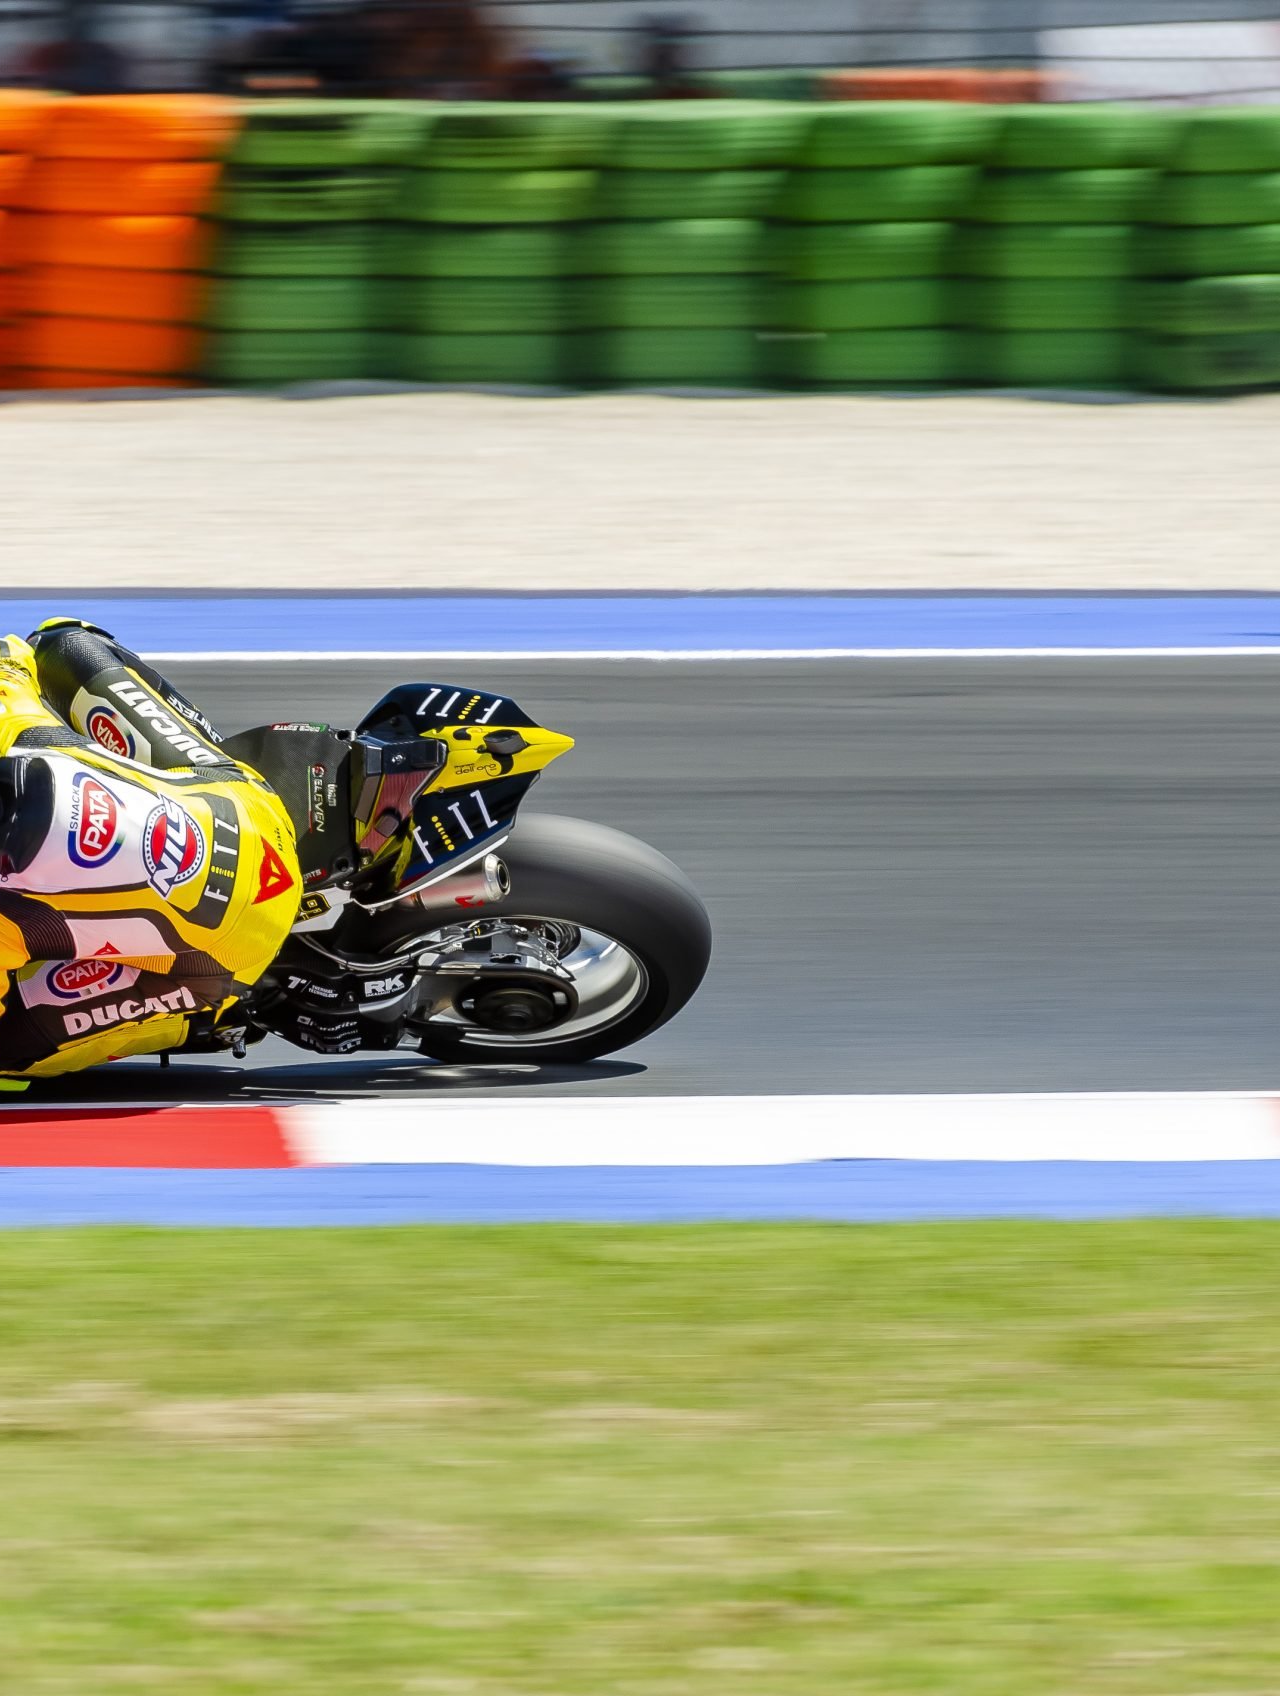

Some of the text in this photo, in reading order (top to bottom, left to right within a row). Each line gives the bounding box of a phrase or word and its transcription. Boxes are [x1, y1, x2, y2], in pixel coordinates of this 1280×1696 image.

[108, 681, 219, 766] DUCATI
[69, 786, 80, 829] SNACK
[83, 790, 111, 850] PATA
[61, 960, 110, 987] PATA
[364, 973, 405, 993] RK
[63, 986, 197, 1036] DUCATI
